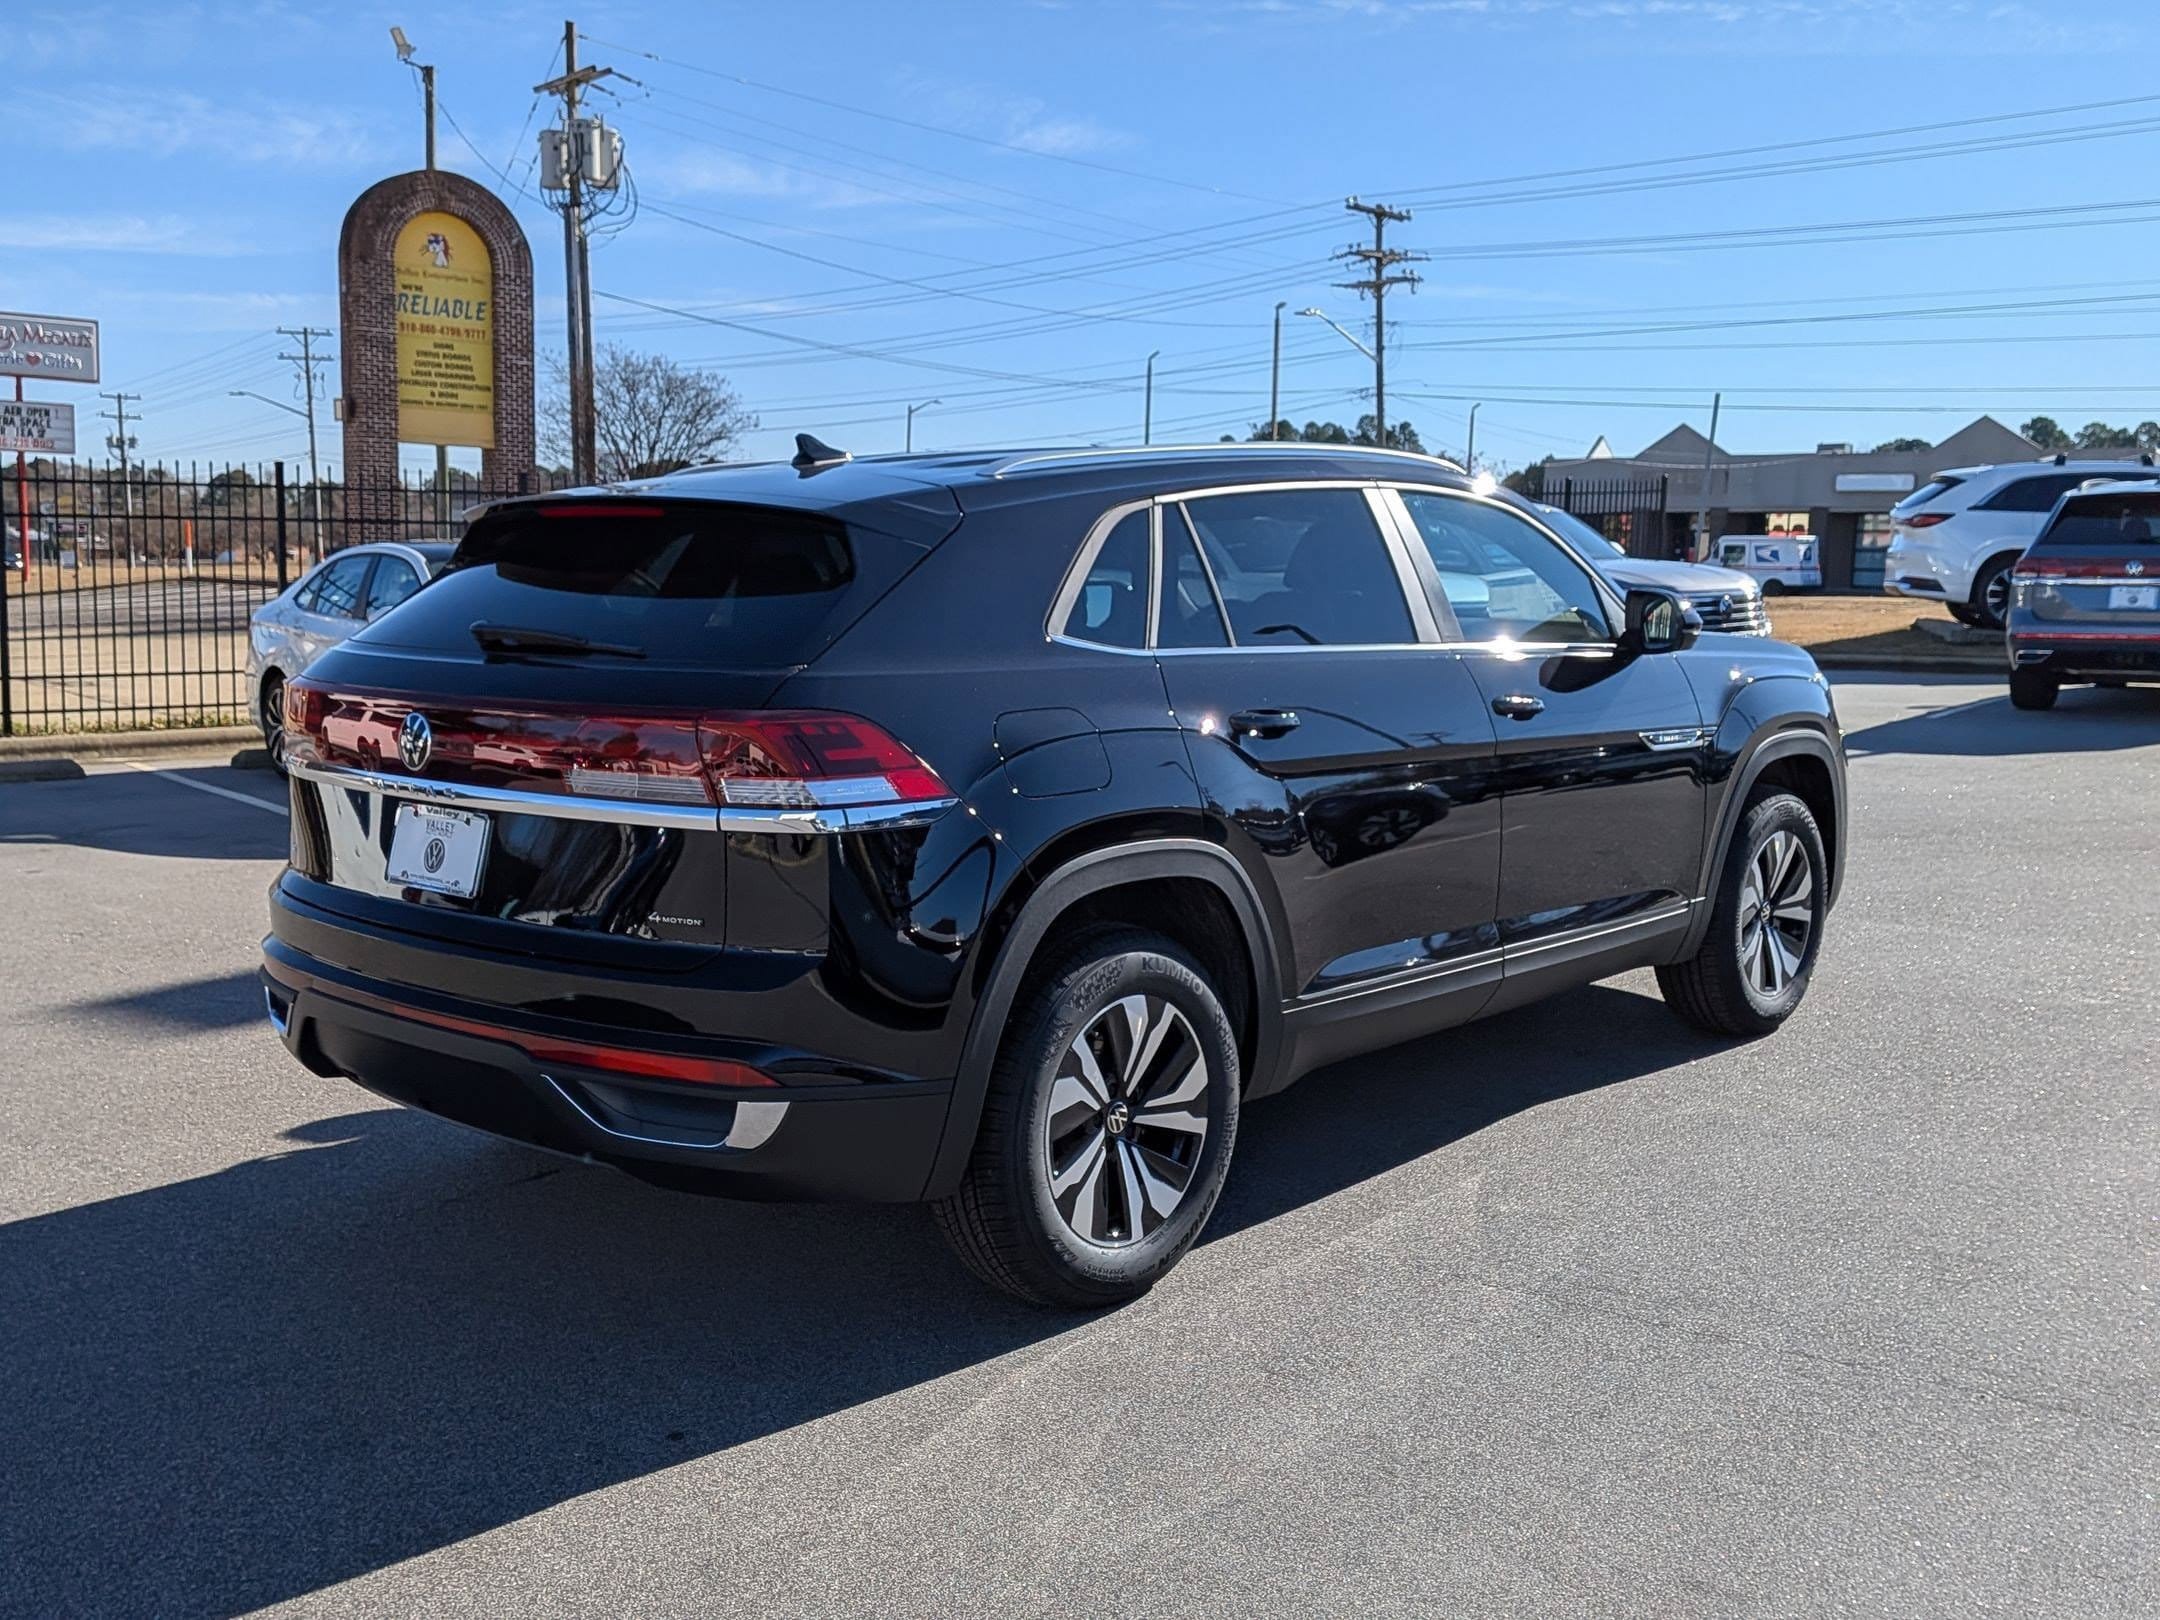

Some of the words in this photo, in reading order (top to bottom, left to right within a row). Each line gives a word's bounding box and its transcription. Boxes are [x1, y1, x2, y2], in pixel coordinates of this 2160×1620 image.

[396, 293, 487, 321] RELIABLE
[425, 806, 460, 819] Valley
[1141, 956, 1204, 996] KUMHO
